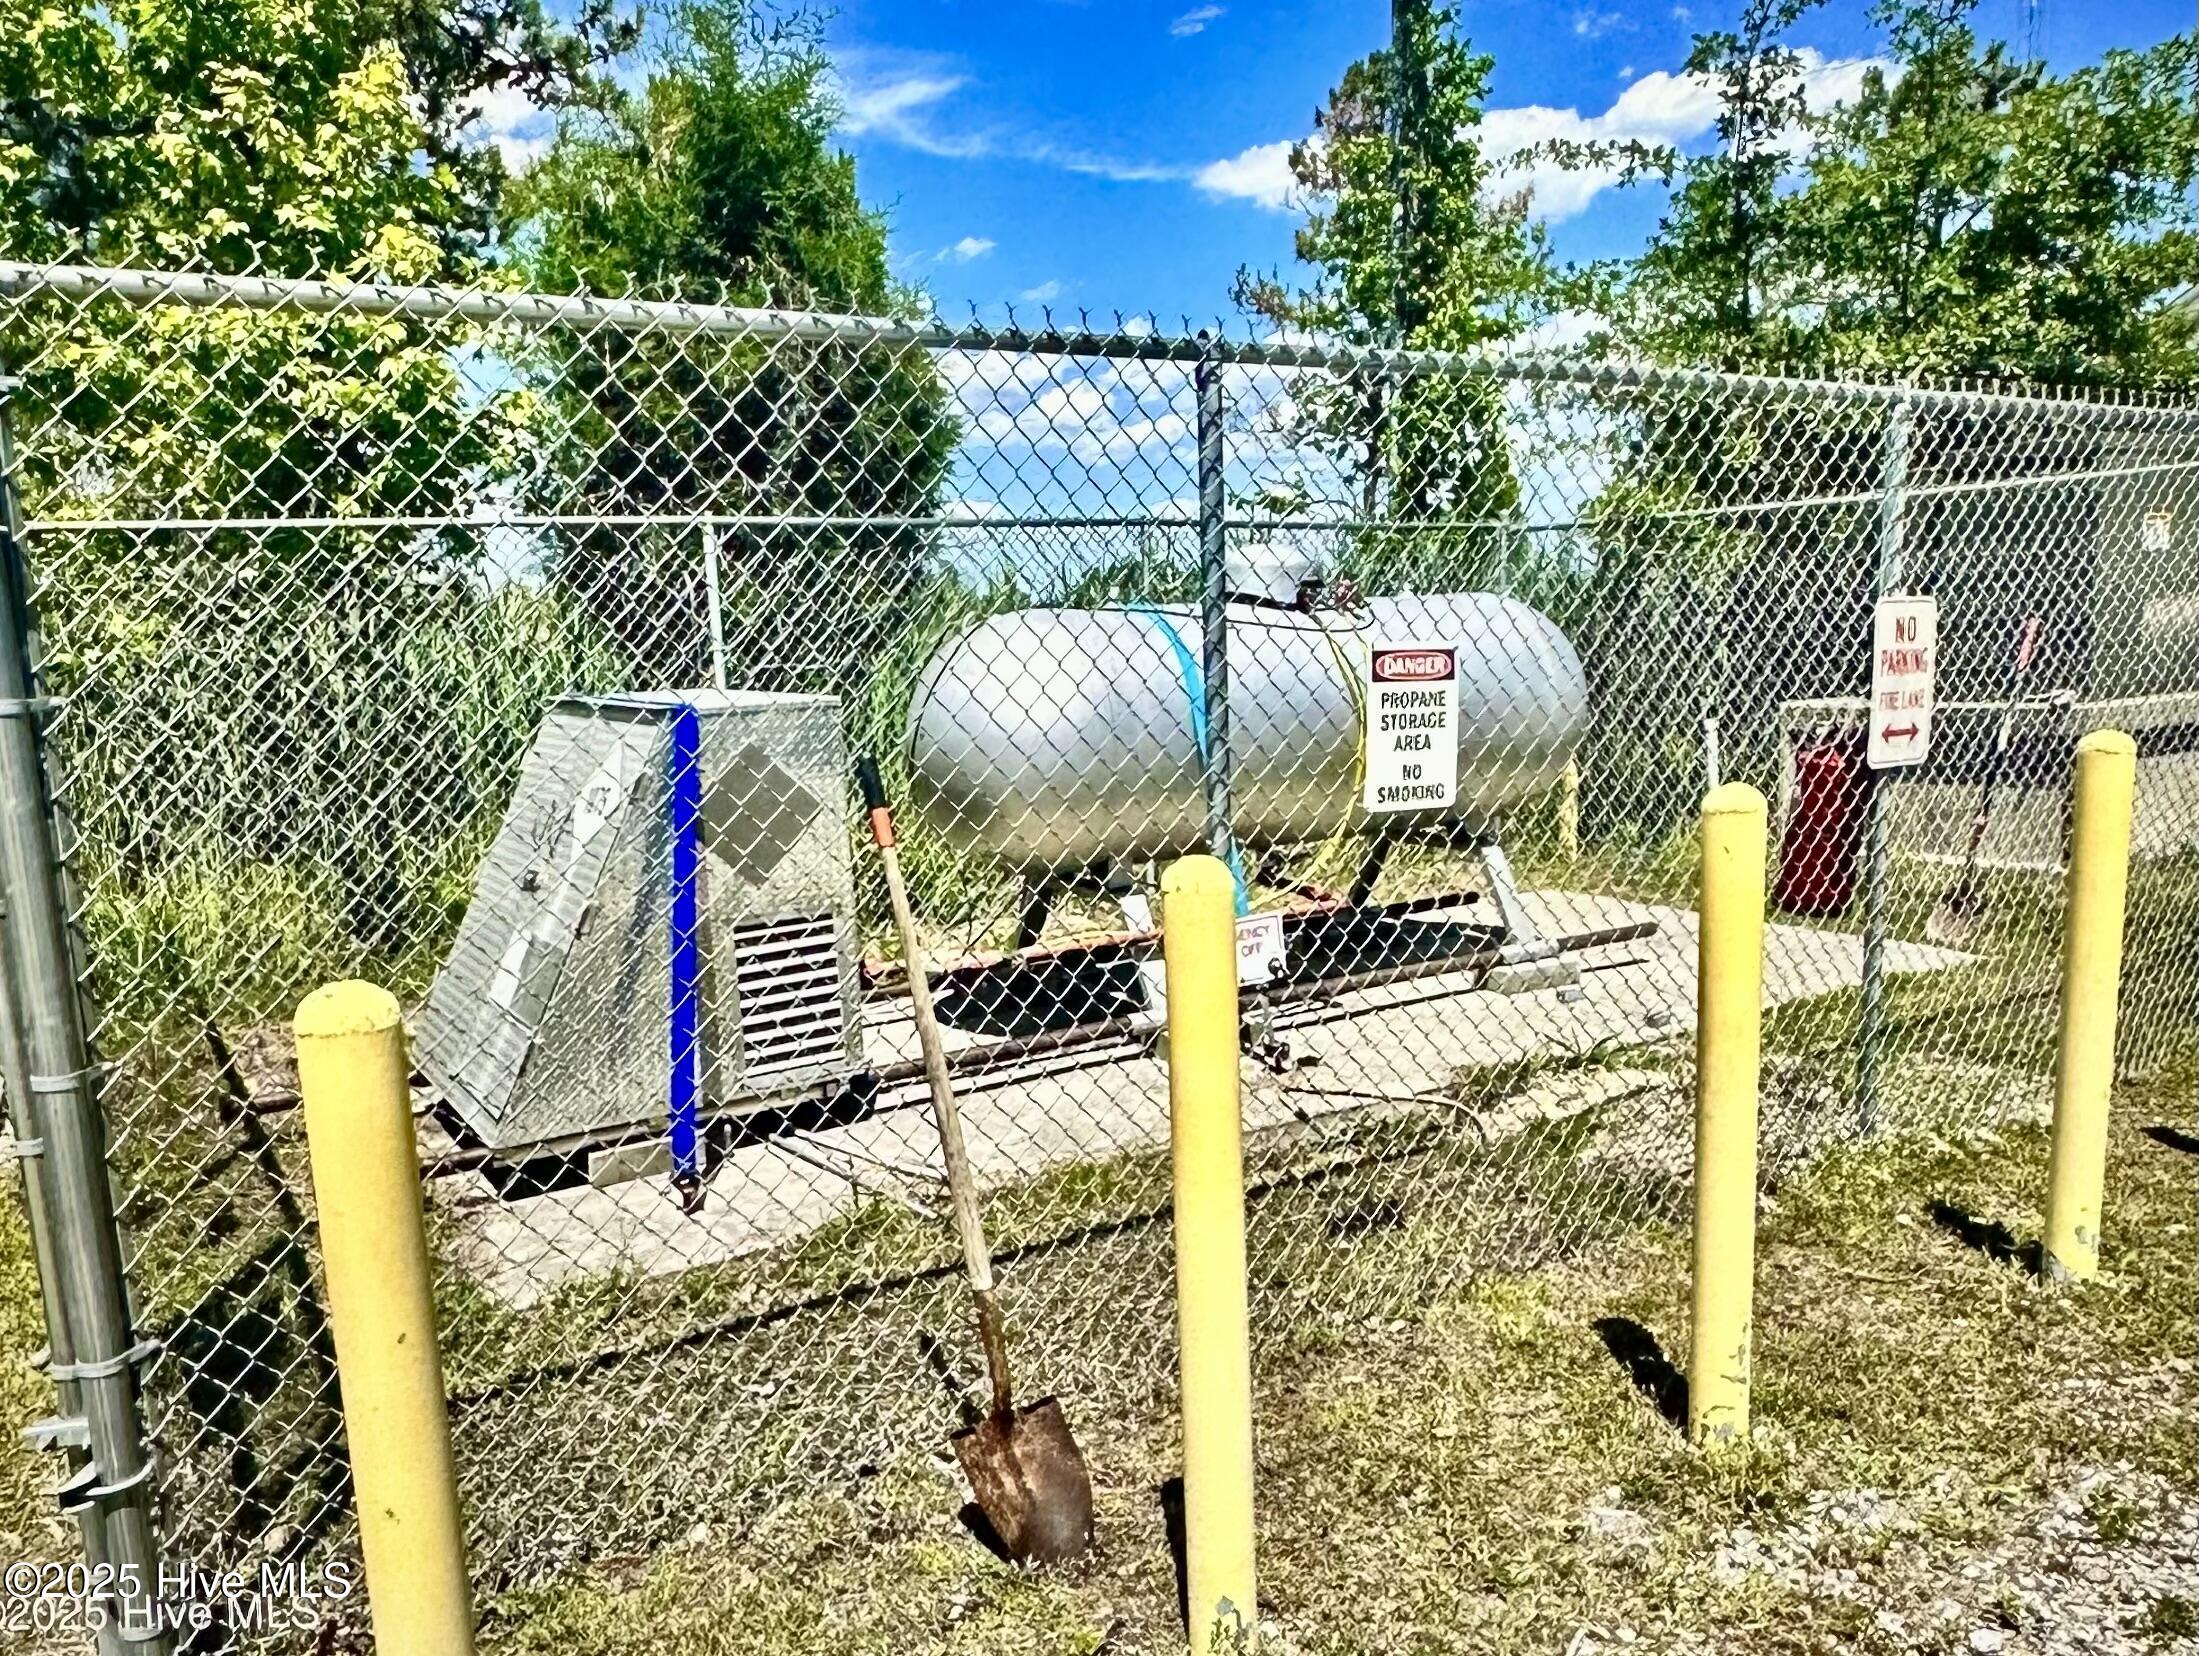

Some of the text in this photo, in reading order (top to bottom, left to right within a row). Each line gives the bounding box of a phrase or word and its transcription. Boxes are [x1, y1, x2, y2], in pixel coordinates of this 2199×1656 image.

[1894, 615, 1918, 644] NO
[1383, 656, 1446, 675] DANGER
[1880, 647, 1928, 677] PARKING
[1380, 689, 1447, 709] PROPANE
[1380, 711, 1447, 731] STORAGE
[1393, 734, 1432, 752] AREA
[1402, 763, 1422, 781] NO
[1377, 783, 1445, 804] SMOKING
[1237, 925, 1270, 941] ENCY
